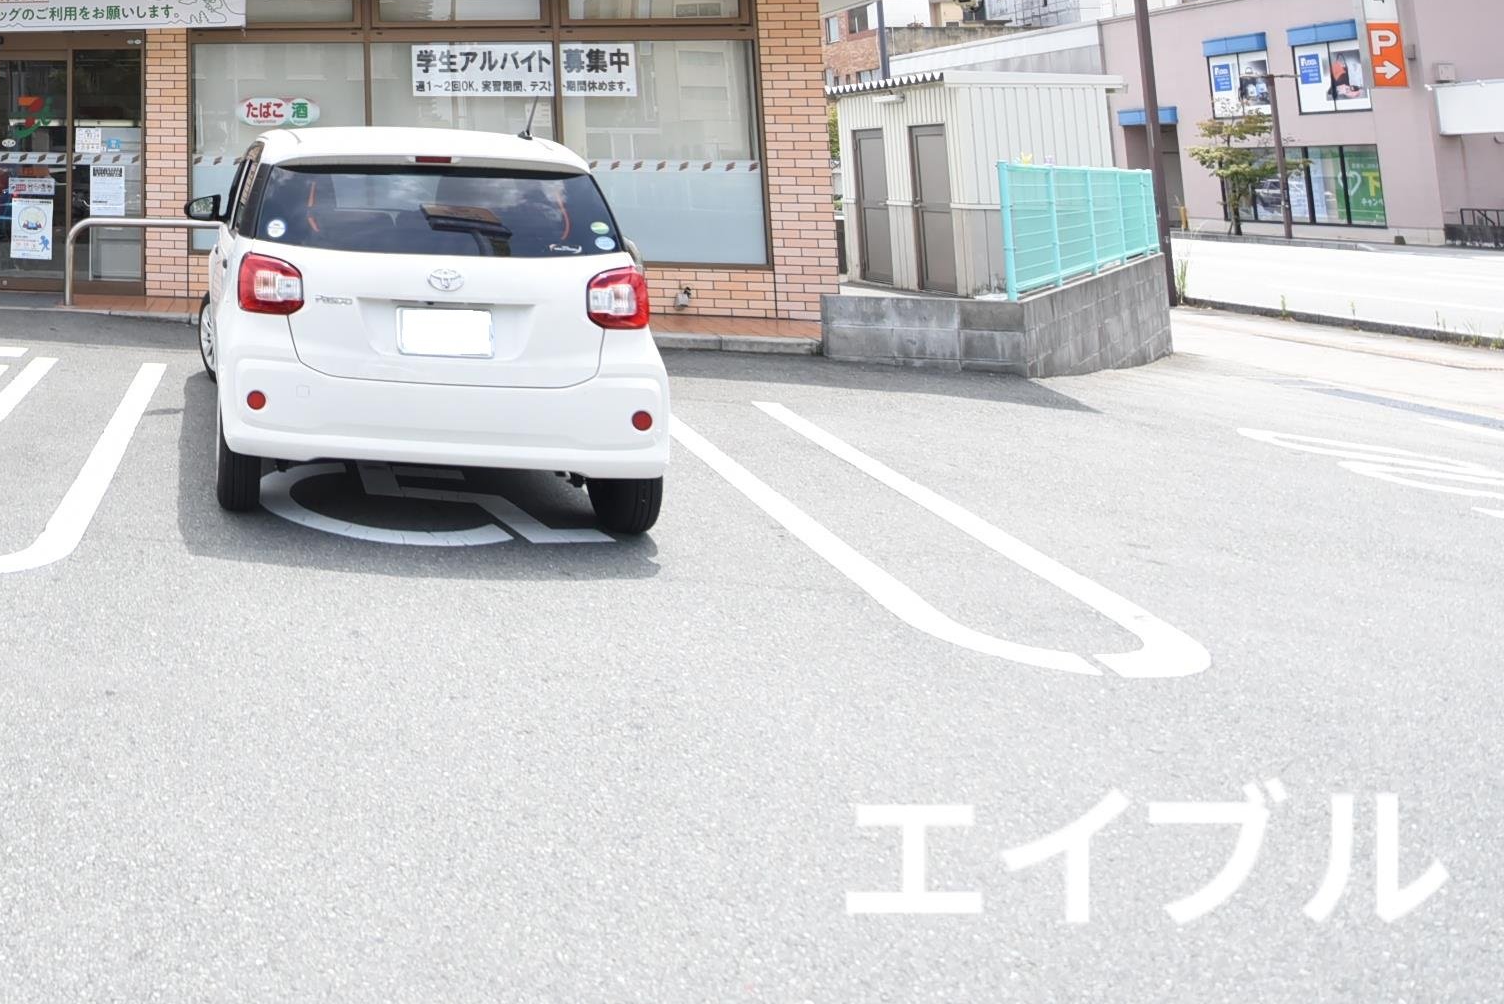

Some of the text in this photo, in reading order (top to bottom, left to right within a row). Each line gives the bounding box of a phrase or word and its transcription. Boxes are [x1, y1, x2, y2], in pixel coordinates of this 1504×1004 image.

[1370, 29, 1398, 55] P
[416, 48, 630, 74] 学生アルバイト 募集中
[246, 102, 308, 118] たばこ 酒
